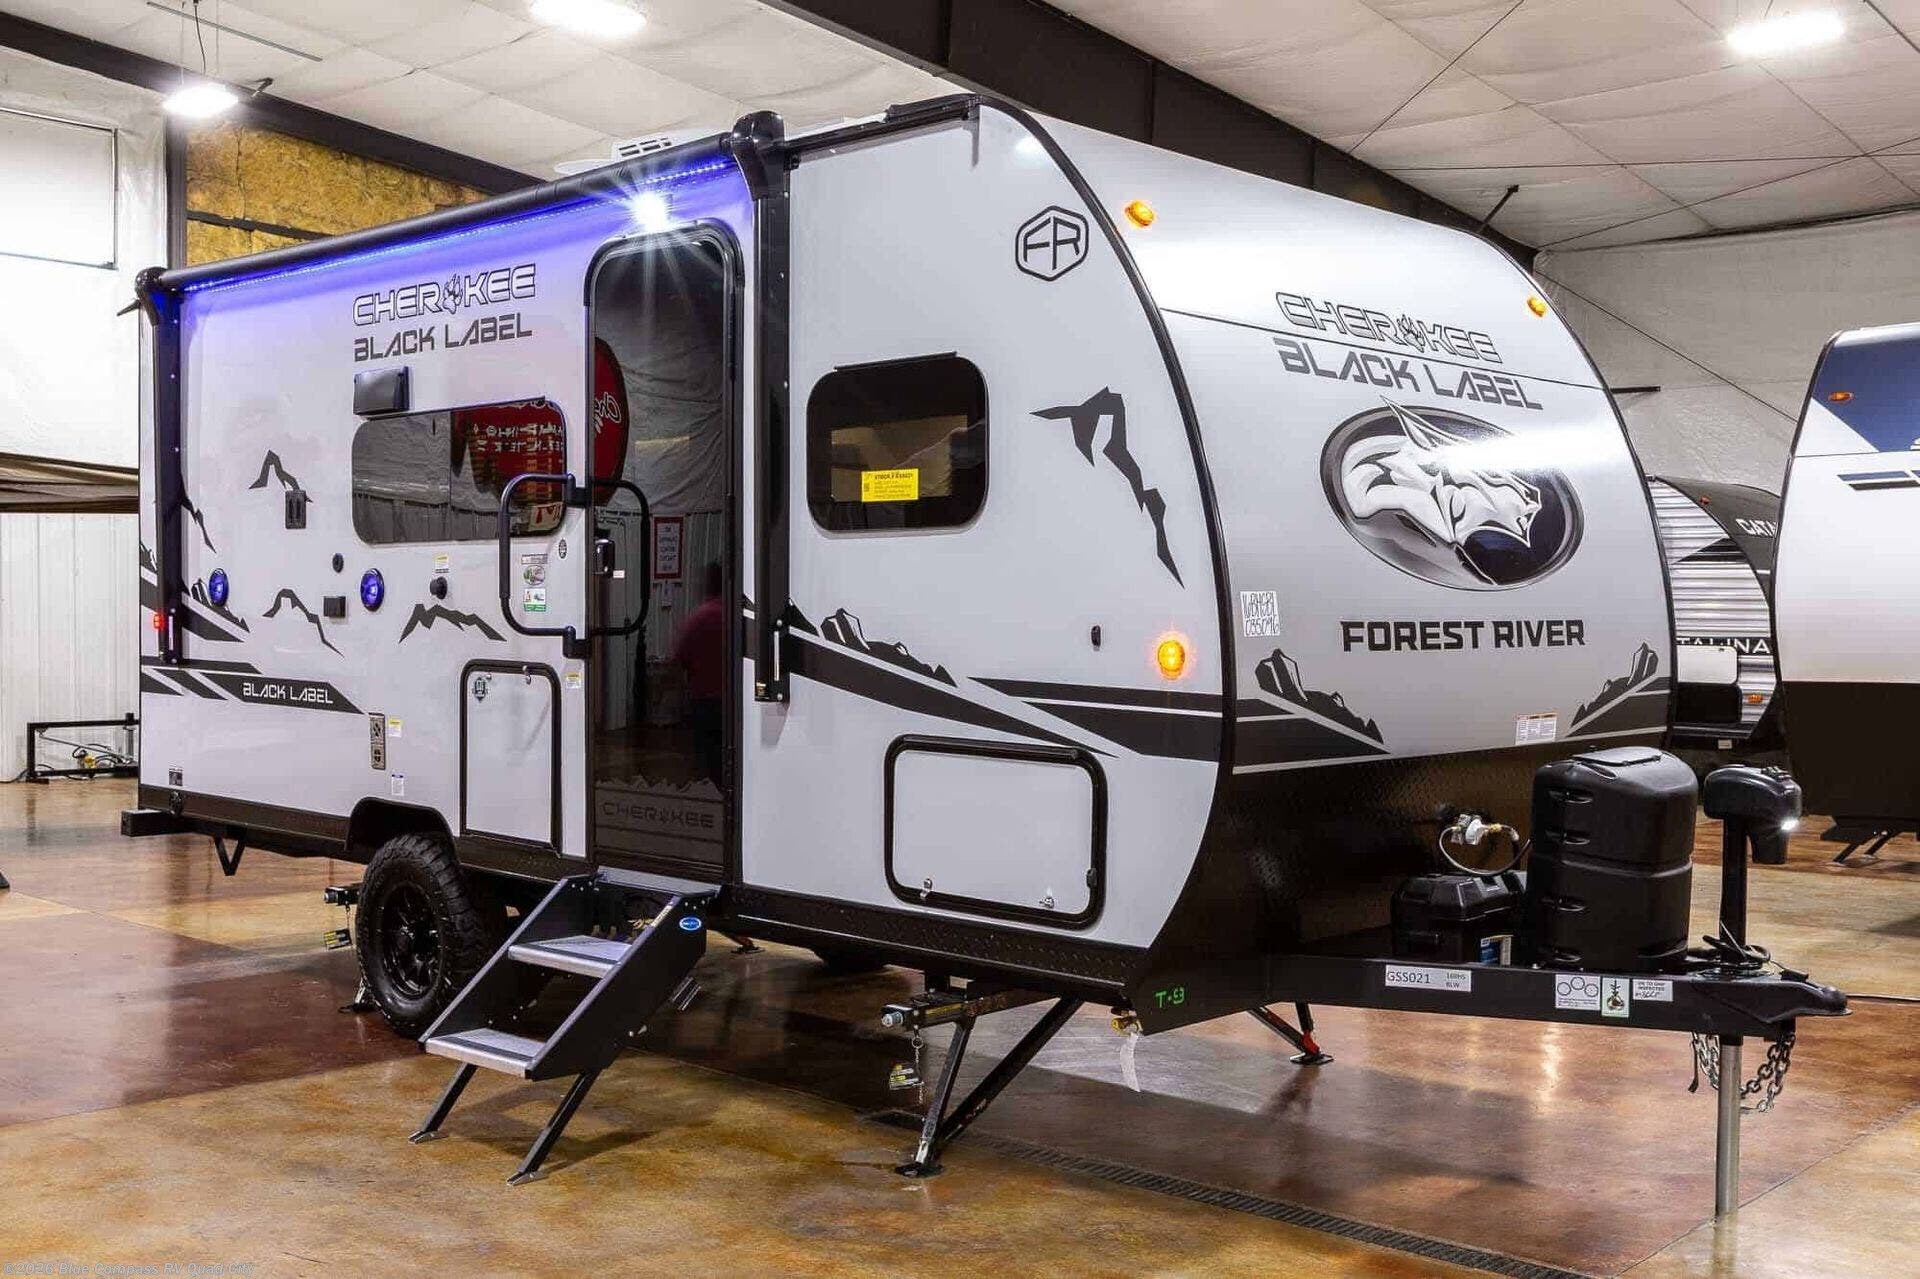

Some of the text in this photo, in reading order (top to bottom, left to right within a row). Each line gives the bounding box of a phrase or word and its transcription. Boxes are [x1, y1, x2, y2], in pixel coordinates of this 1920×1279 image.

[354, 312, 533, 362] BLACK LABEL
[1272, 337, 1544, 411] BLACK LABEL
[1340, 619, 1586, 653] FOREST RIVER
[242, 682, 334, 704] BLACK LABEL
